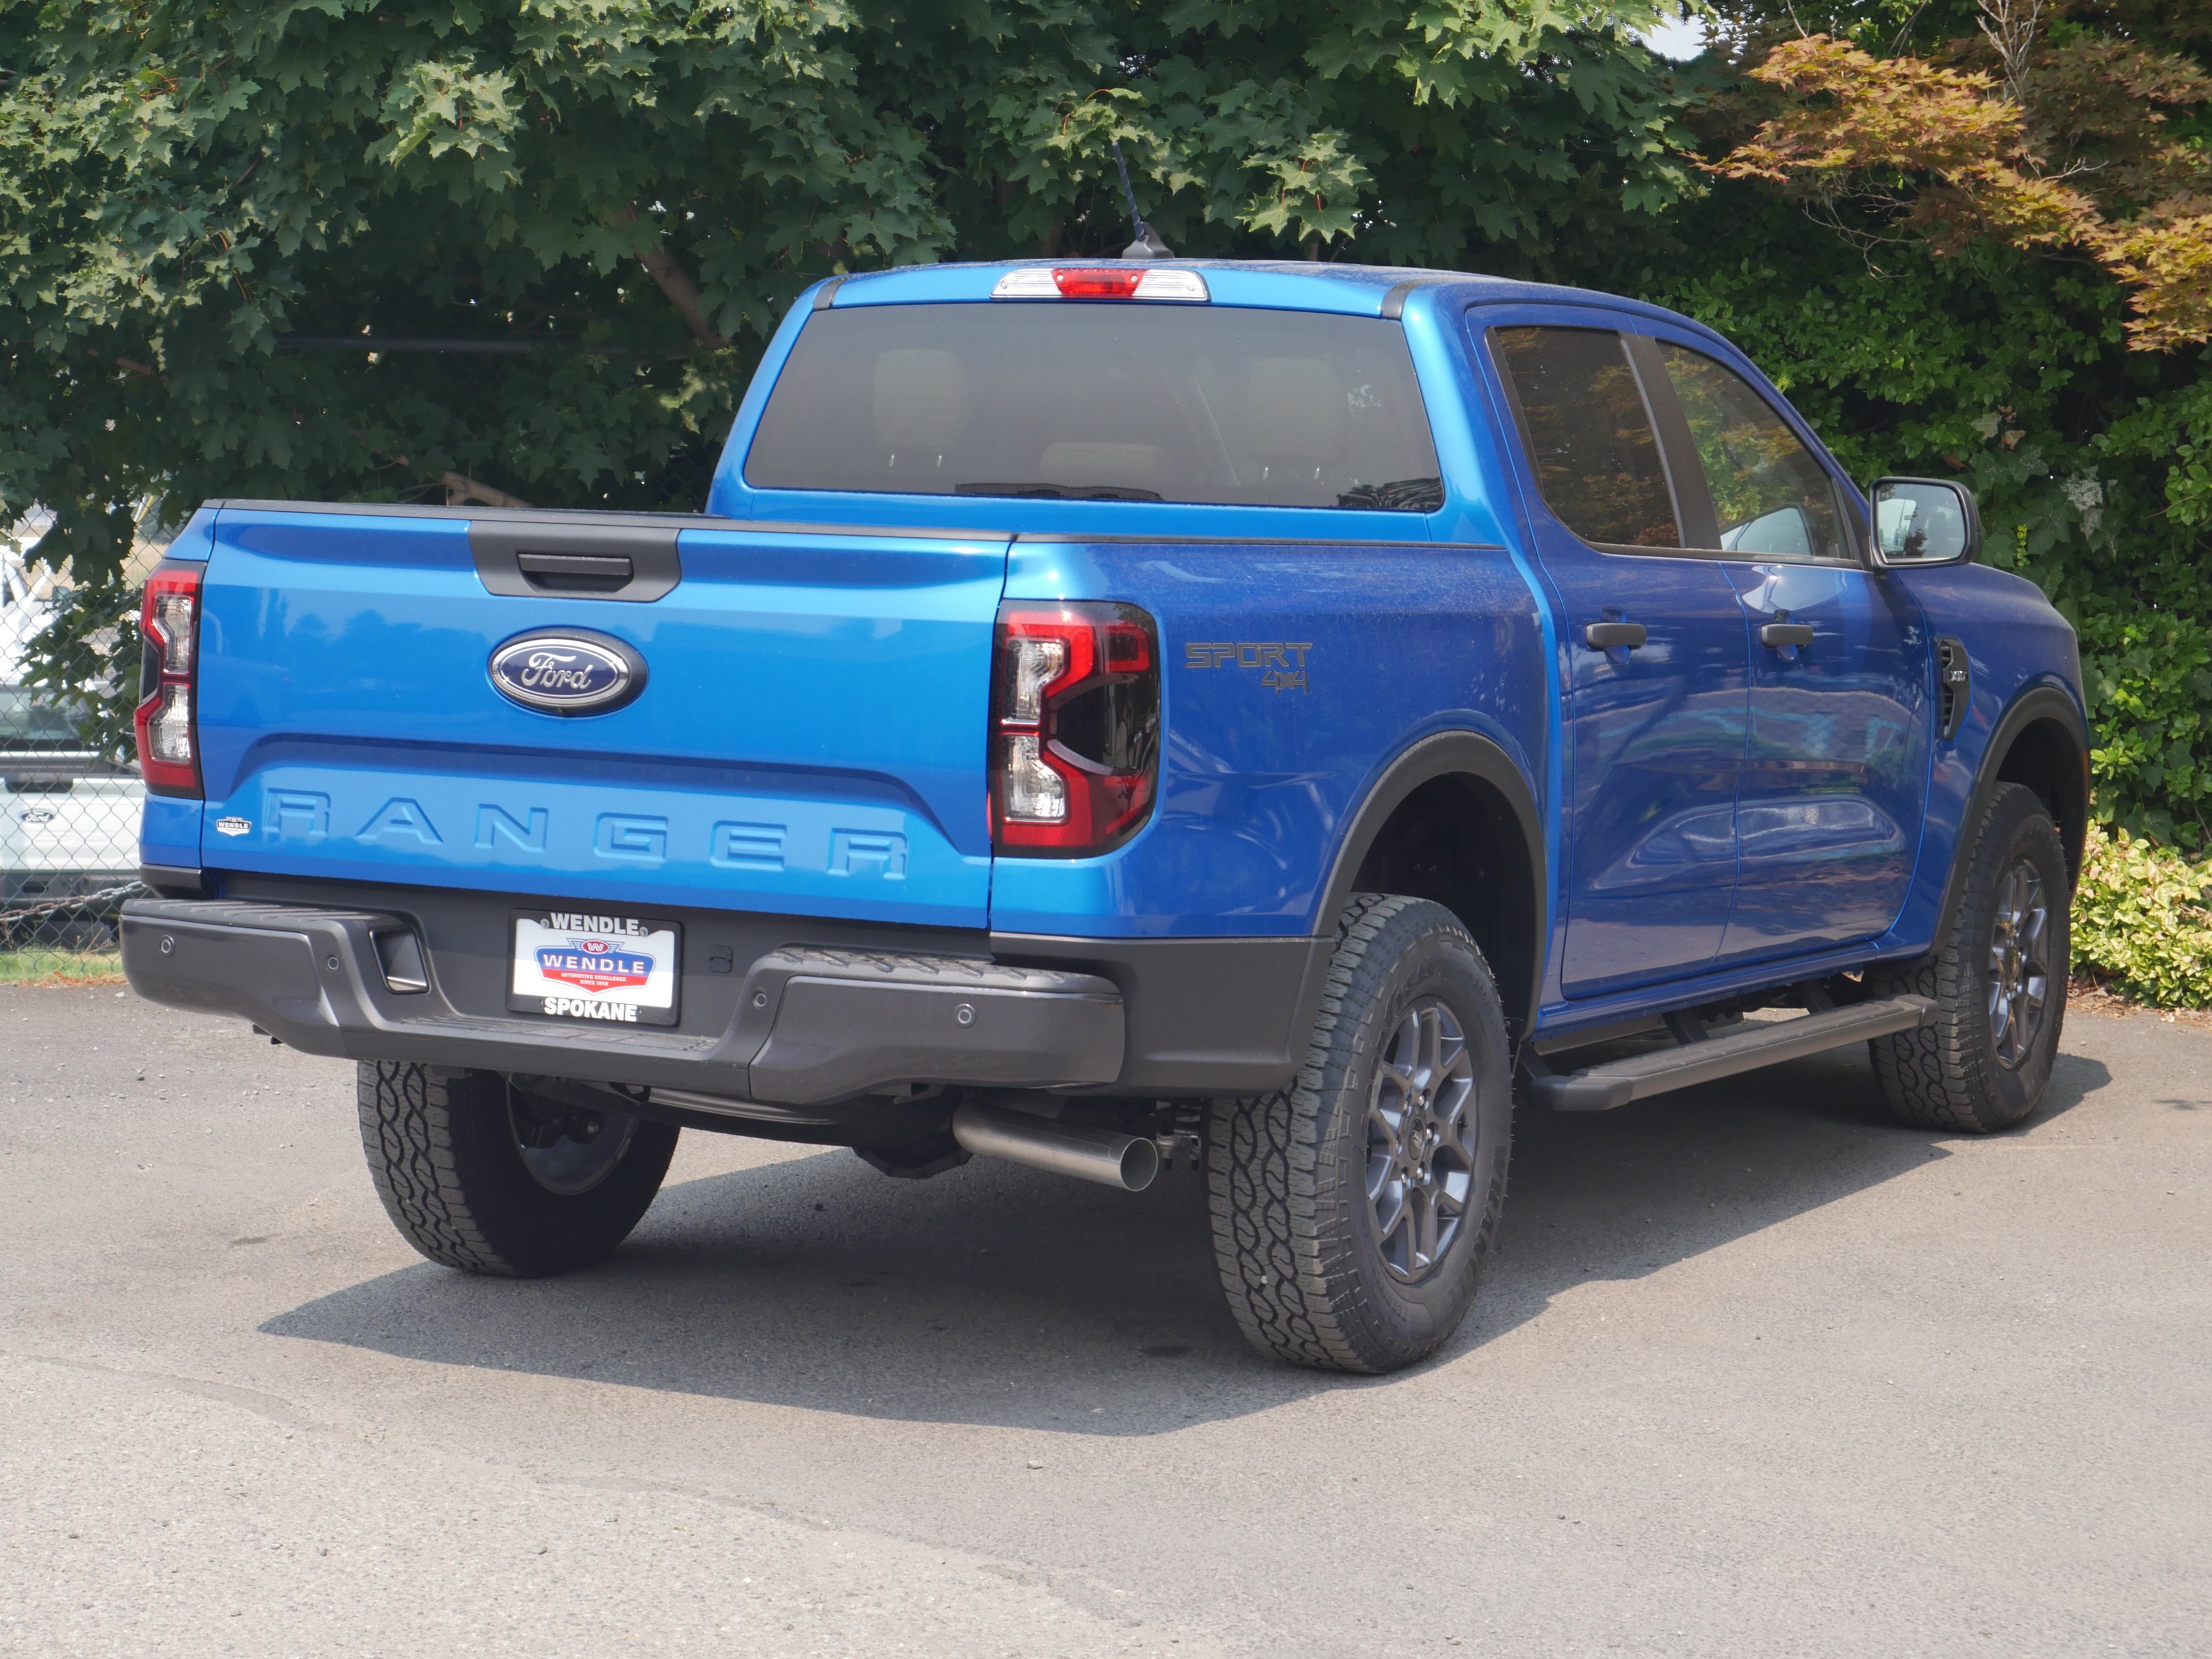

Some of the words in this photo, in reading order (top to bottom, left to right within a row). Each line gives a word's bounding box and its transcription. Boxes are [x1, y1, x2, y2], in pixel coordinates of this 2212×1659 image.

[1185, 643, 1313, 668] SPORT
[522, 652, 591, 689] Ford
[262, 788, 908, 879] RANGER
[550, 912, 639, 936] WENDLE
[543, 954, 644, 974] WENDLE
[543, 997, 637, 1022] SPOKANE
